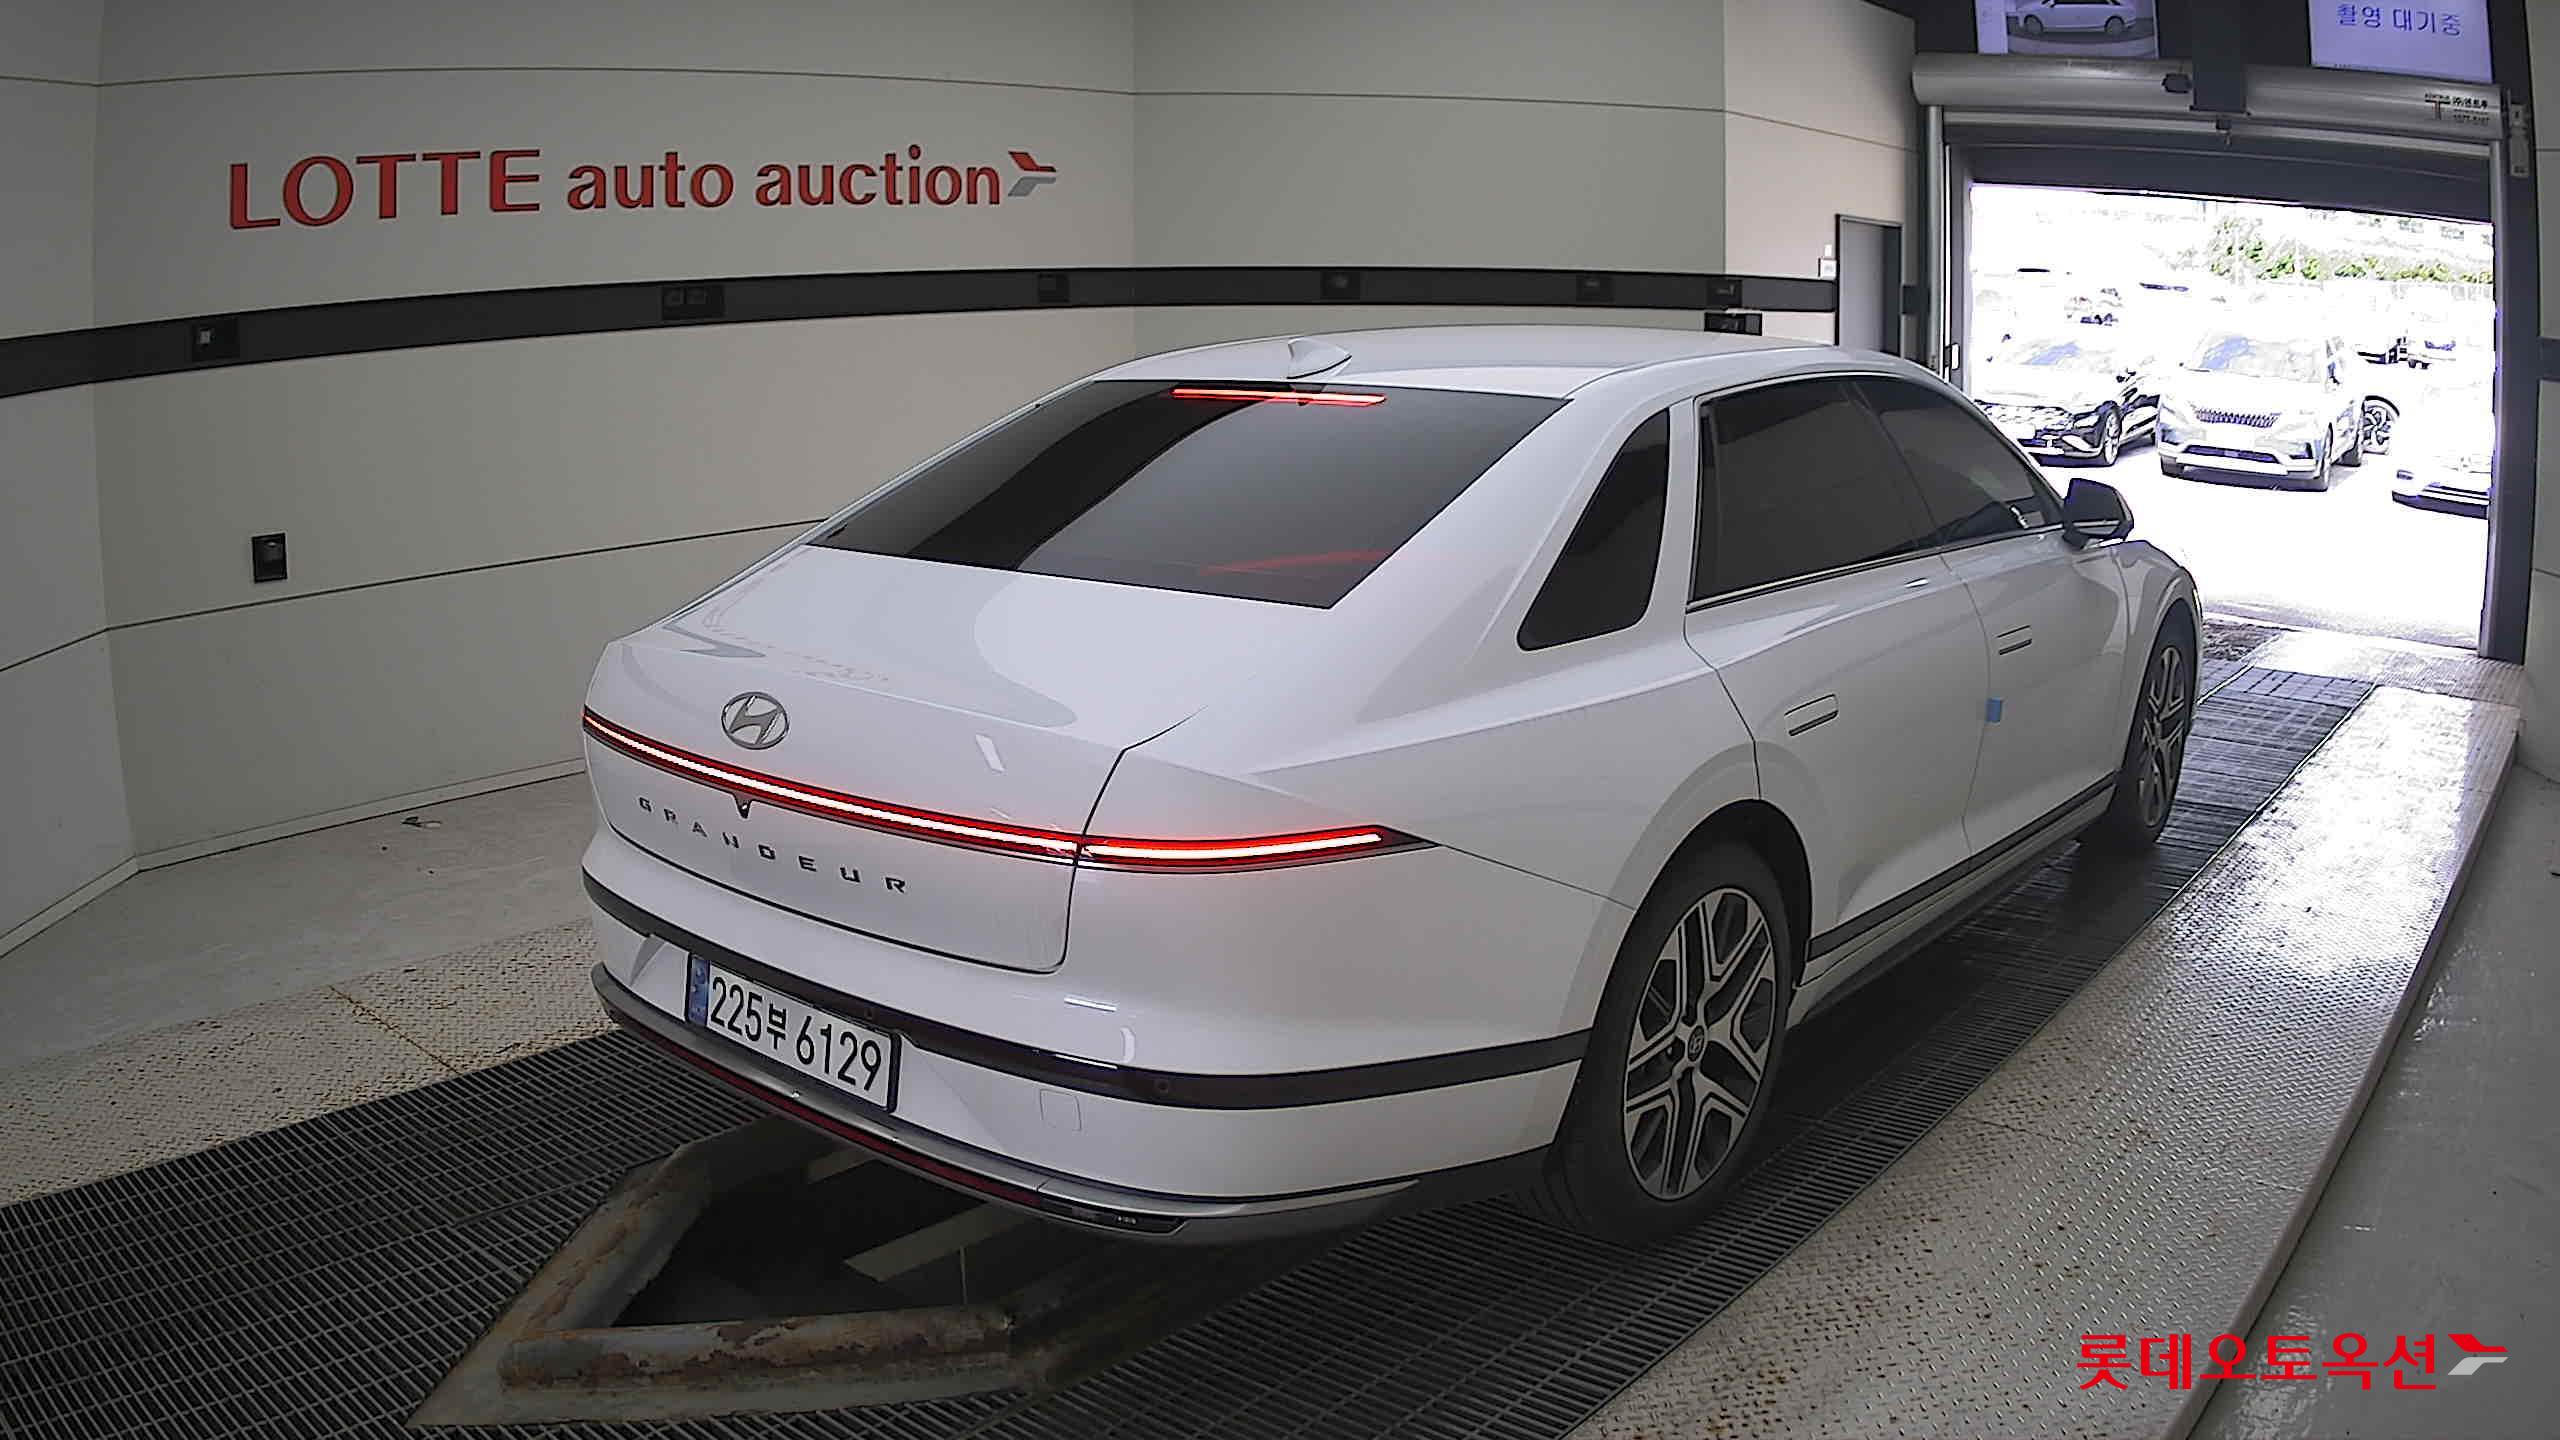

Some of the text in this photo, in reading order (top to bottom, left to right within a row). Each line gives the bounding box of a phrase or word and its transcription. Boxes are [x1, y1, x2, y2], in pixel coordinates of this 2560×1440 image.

[2337, 4, 2462, 37] 촬영 대기중
[228, 144, 1002, 230] LOTTE auto auction
[638, 796, 907, 895] GRANDEUR
